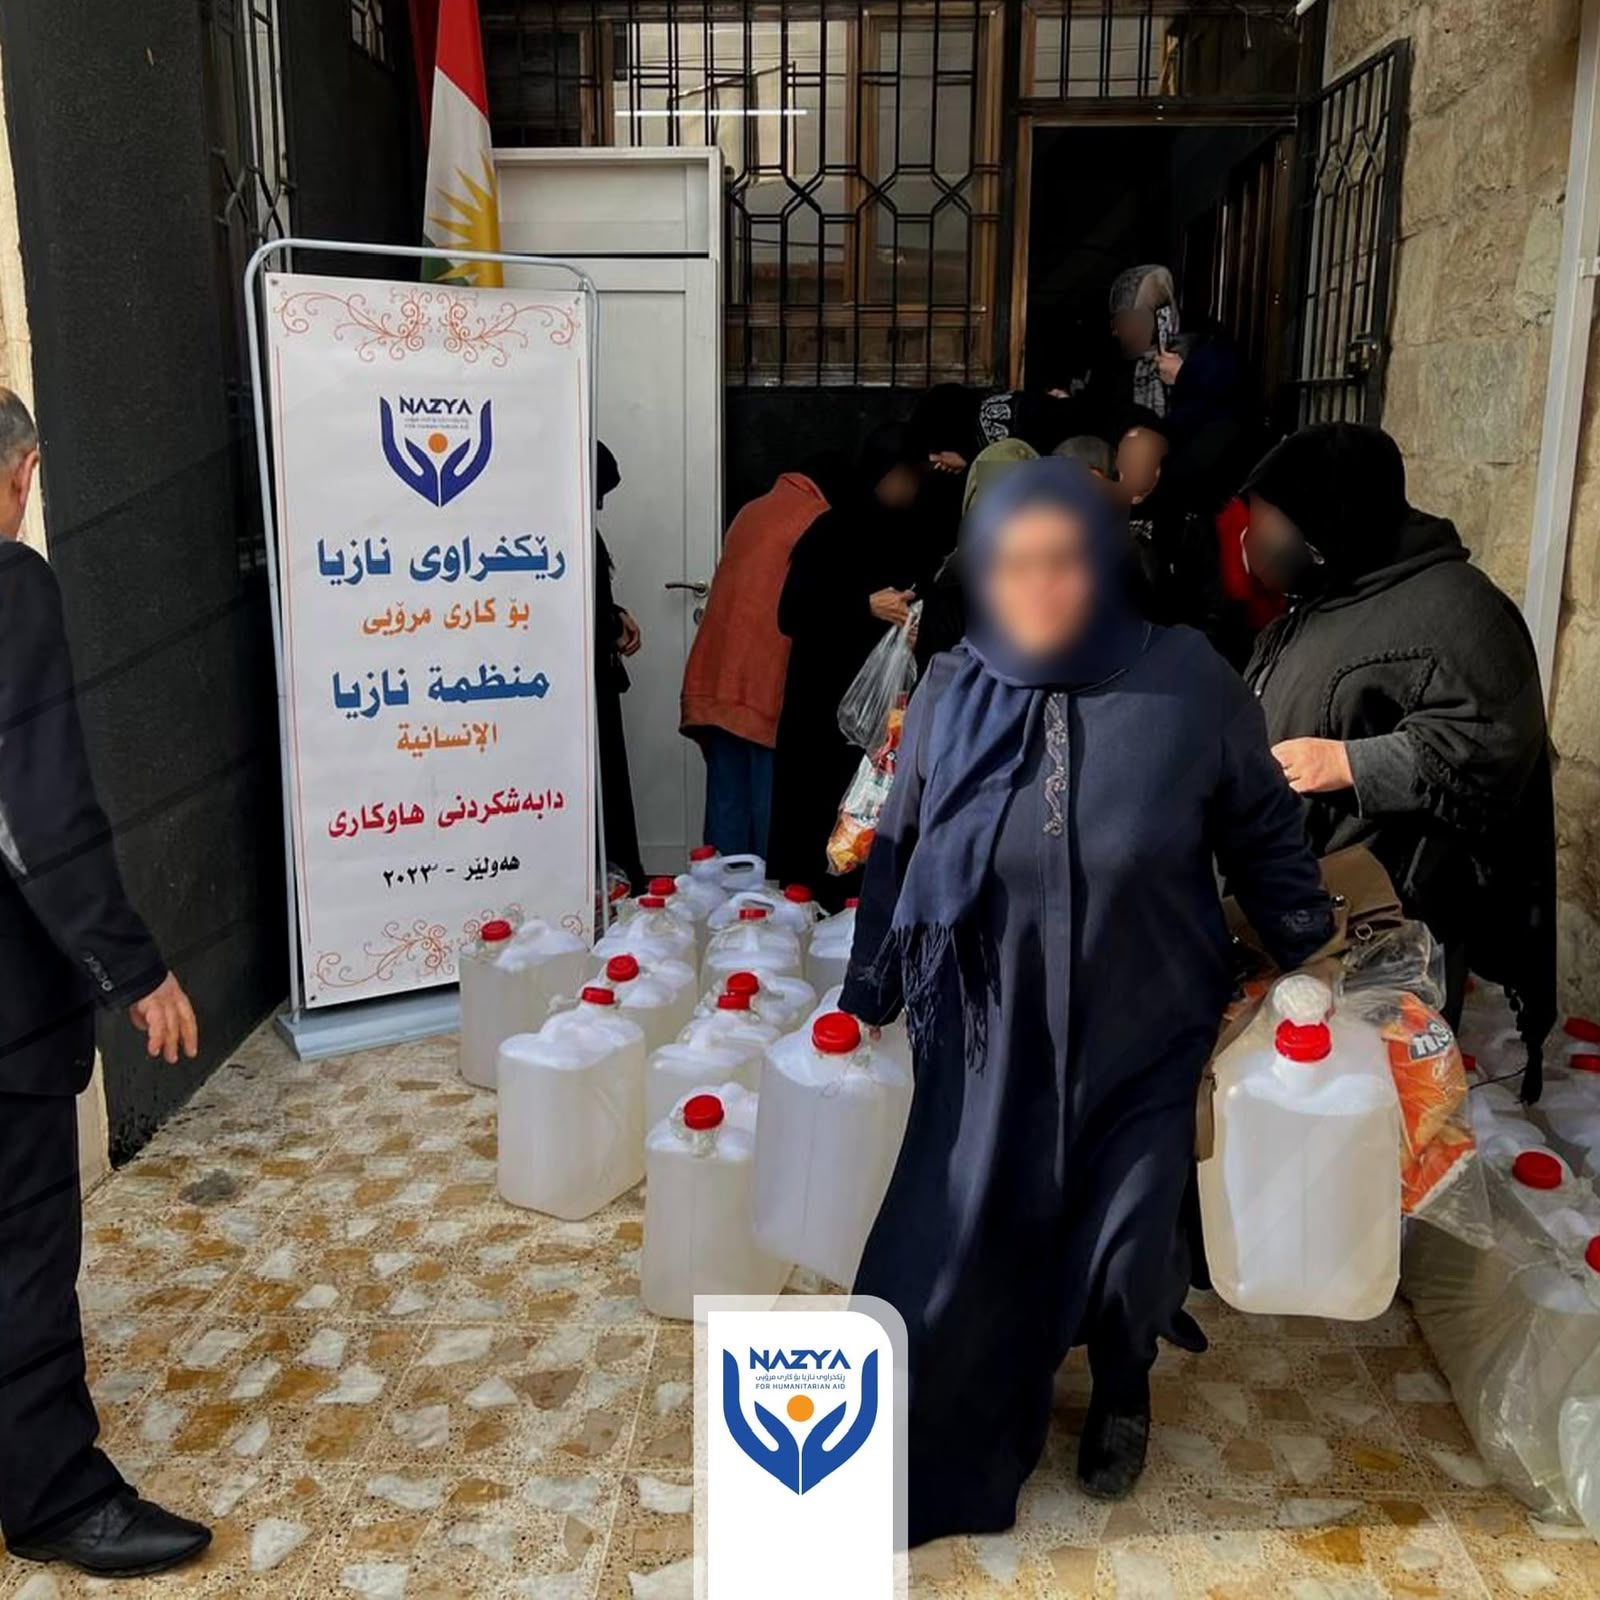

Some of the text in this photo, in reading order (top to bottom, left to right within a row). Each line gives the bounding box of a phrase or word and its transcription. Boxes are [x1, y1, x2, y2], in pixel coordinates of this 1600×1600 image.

[399, 395, 472, 415] NAZYA
[318, 537, 391, 585] نازیا
[443, 597, 495, 630] کاری
[507, 597, 530, 630] بۆ
[428, 664, 550, 704] منظمة
[396, 721, 497, 757] الإنسانية
